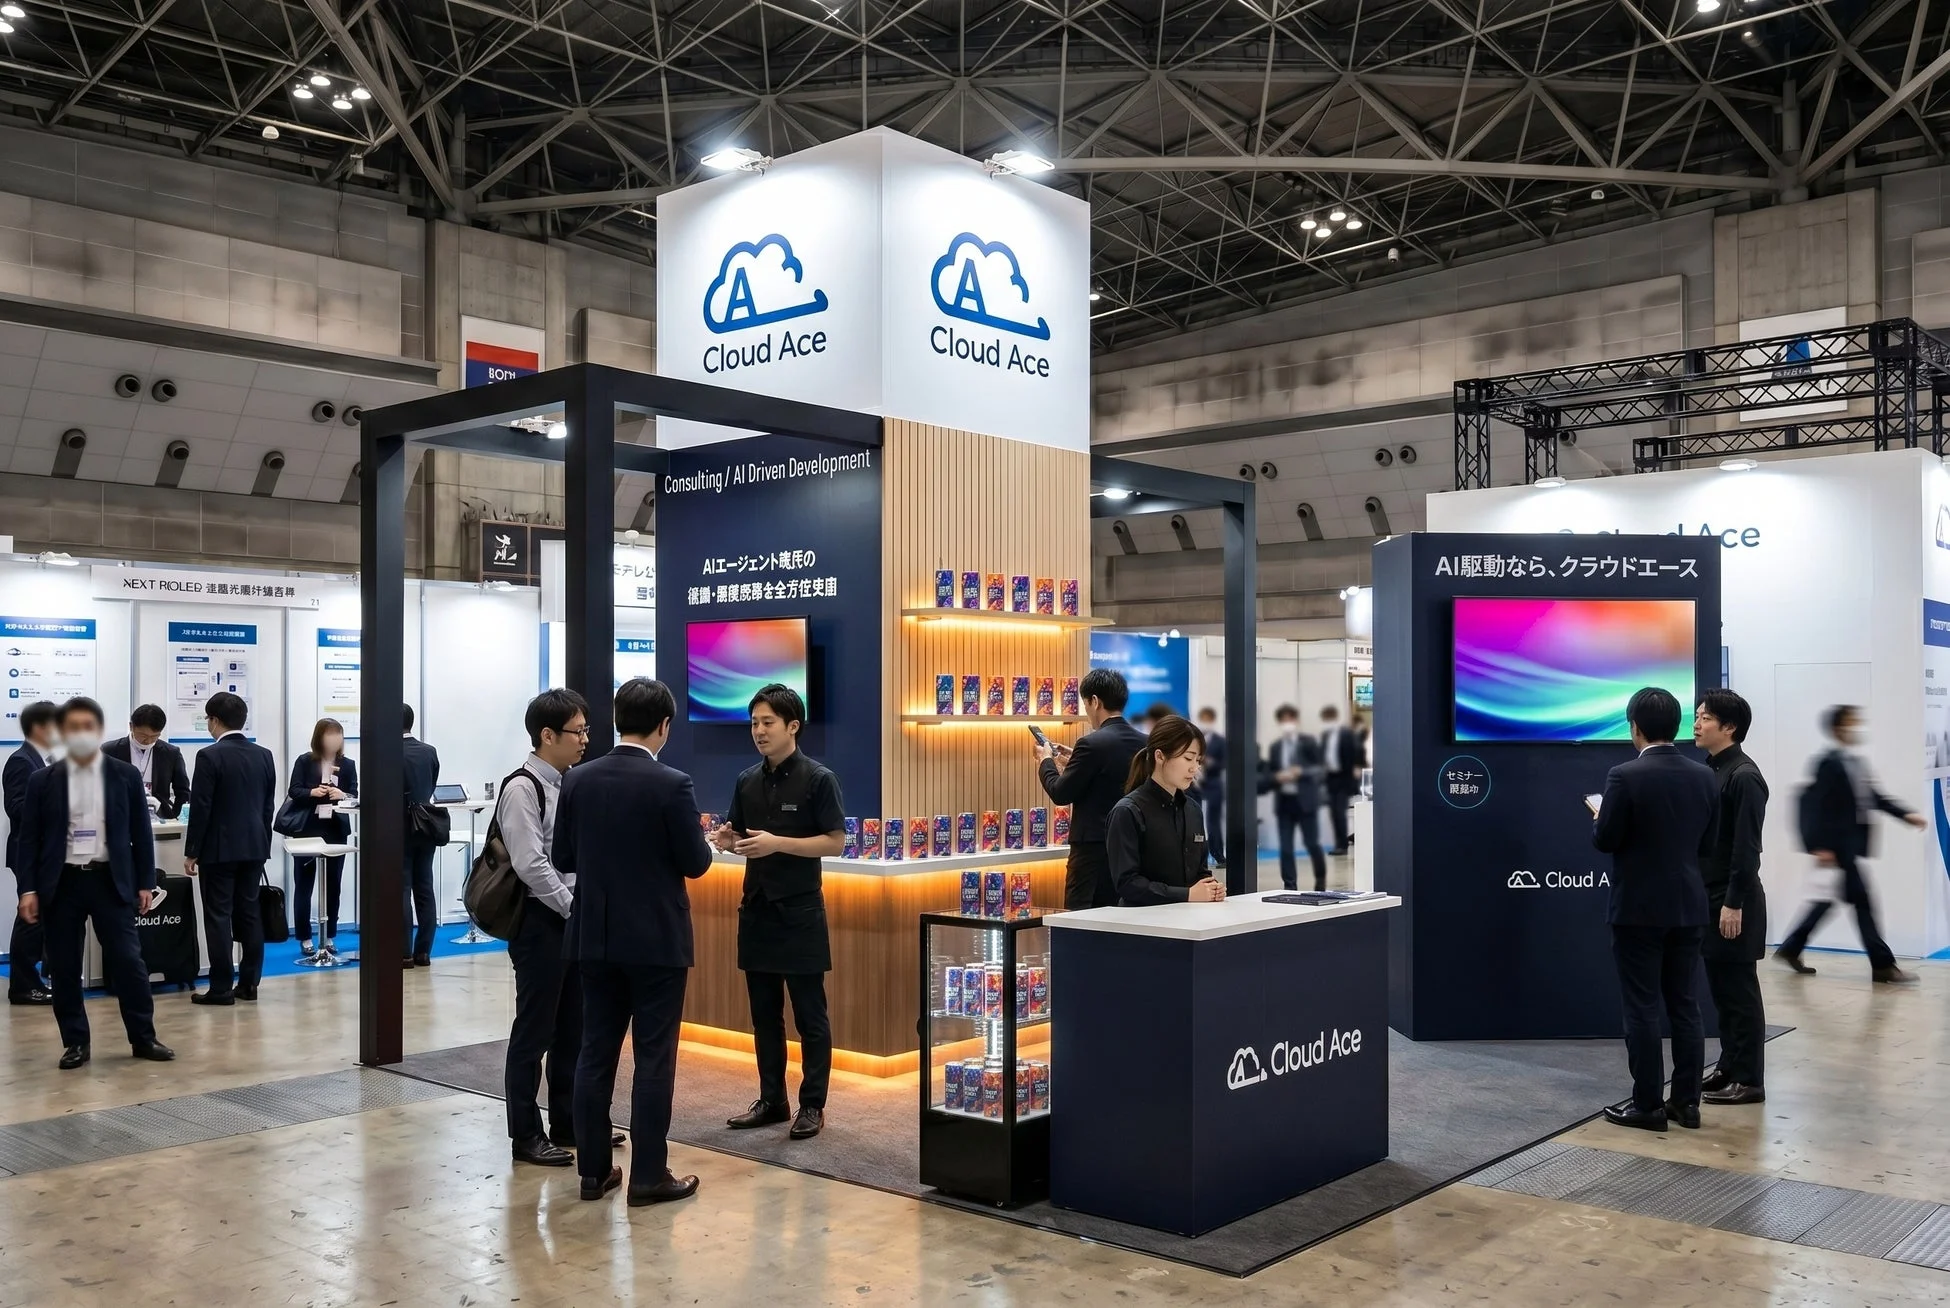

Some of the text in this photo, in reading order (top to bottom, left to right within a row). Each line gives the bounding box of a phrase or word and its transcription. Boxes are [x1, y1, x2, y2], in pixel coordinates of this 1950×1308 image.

[703, 330, 827, 374] Cloud Ace
[930, 325, 1050, 378] Cloud Ace
[664, 470, 723, 494] Consulting
[733, 464, 745, 485] AI
[748, 460, 786, 483] Driven
[789, 449, 871, 479] Development
[1434, 554, 1699, 578] AI駆動なら、クラウドエース
[1545, 870, 1594, 888] Cloud
[162, 915, 182, 925] Ace
[1270, 1031, 1324, 1076] Cloud
[1328, 1028, 1362, 1061] Ace
